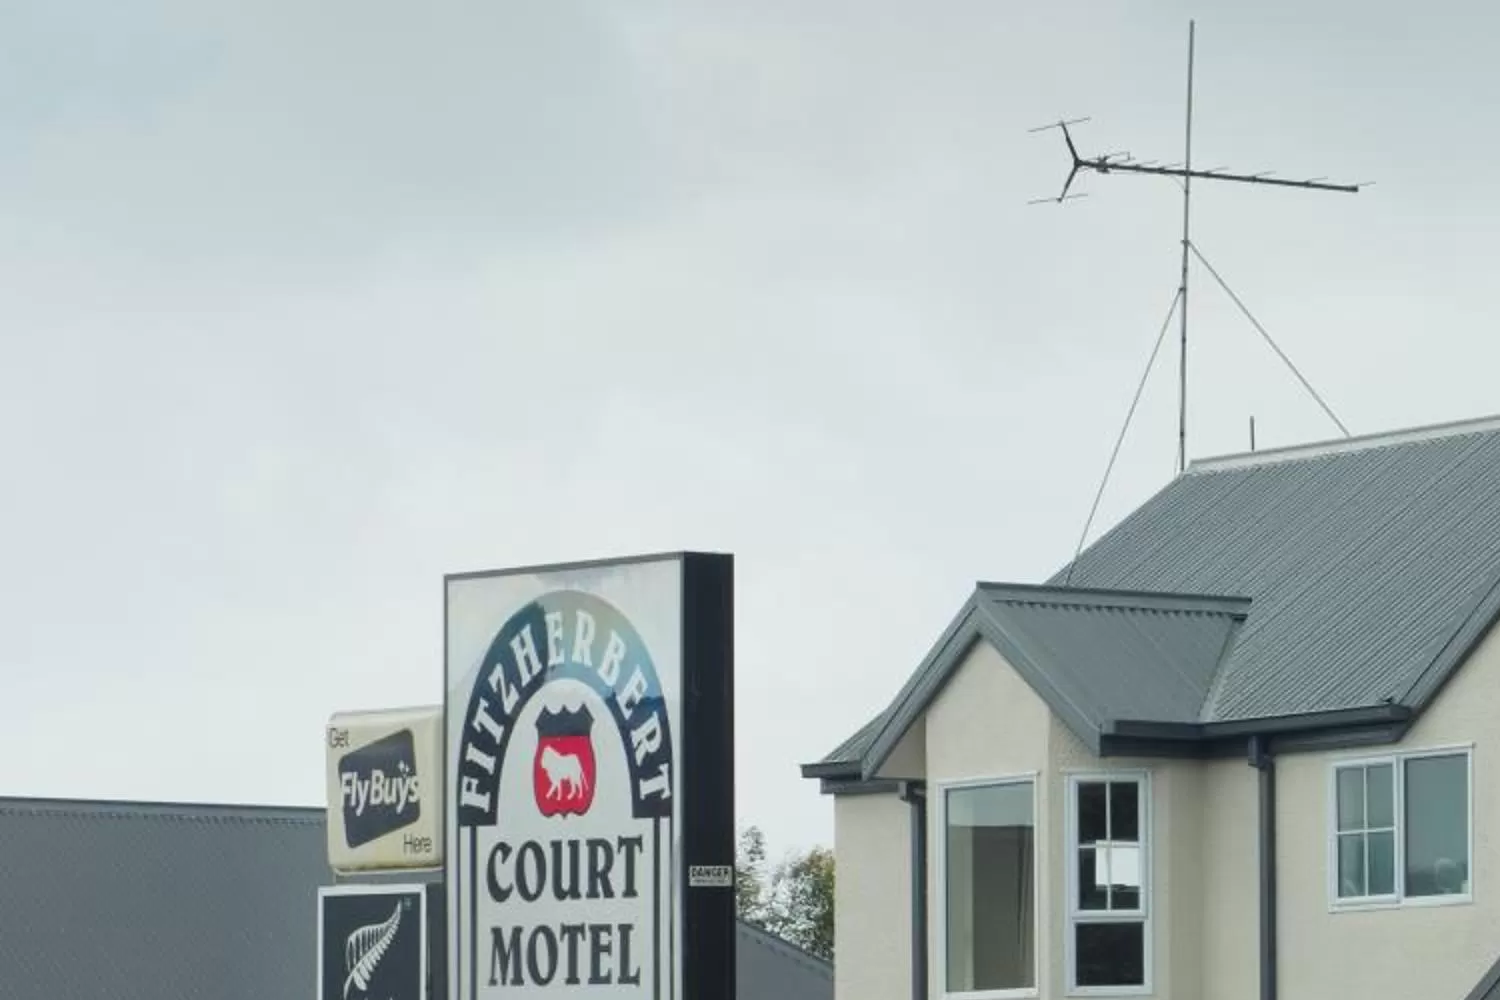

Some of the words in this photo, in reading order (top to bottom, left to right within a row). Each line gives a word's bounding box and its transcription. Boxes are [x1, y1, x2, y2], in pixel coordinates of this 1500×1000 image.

[328, 728, 350, 748] Get
[461, 608, 671, 815] FITZHERBERT
[340, 768, 419, 817] FlyBuys
[403, 833, 432, 854] Here
[486, 834, 645, 903] COURT
[488, 922, 642, 988] MOTEL
